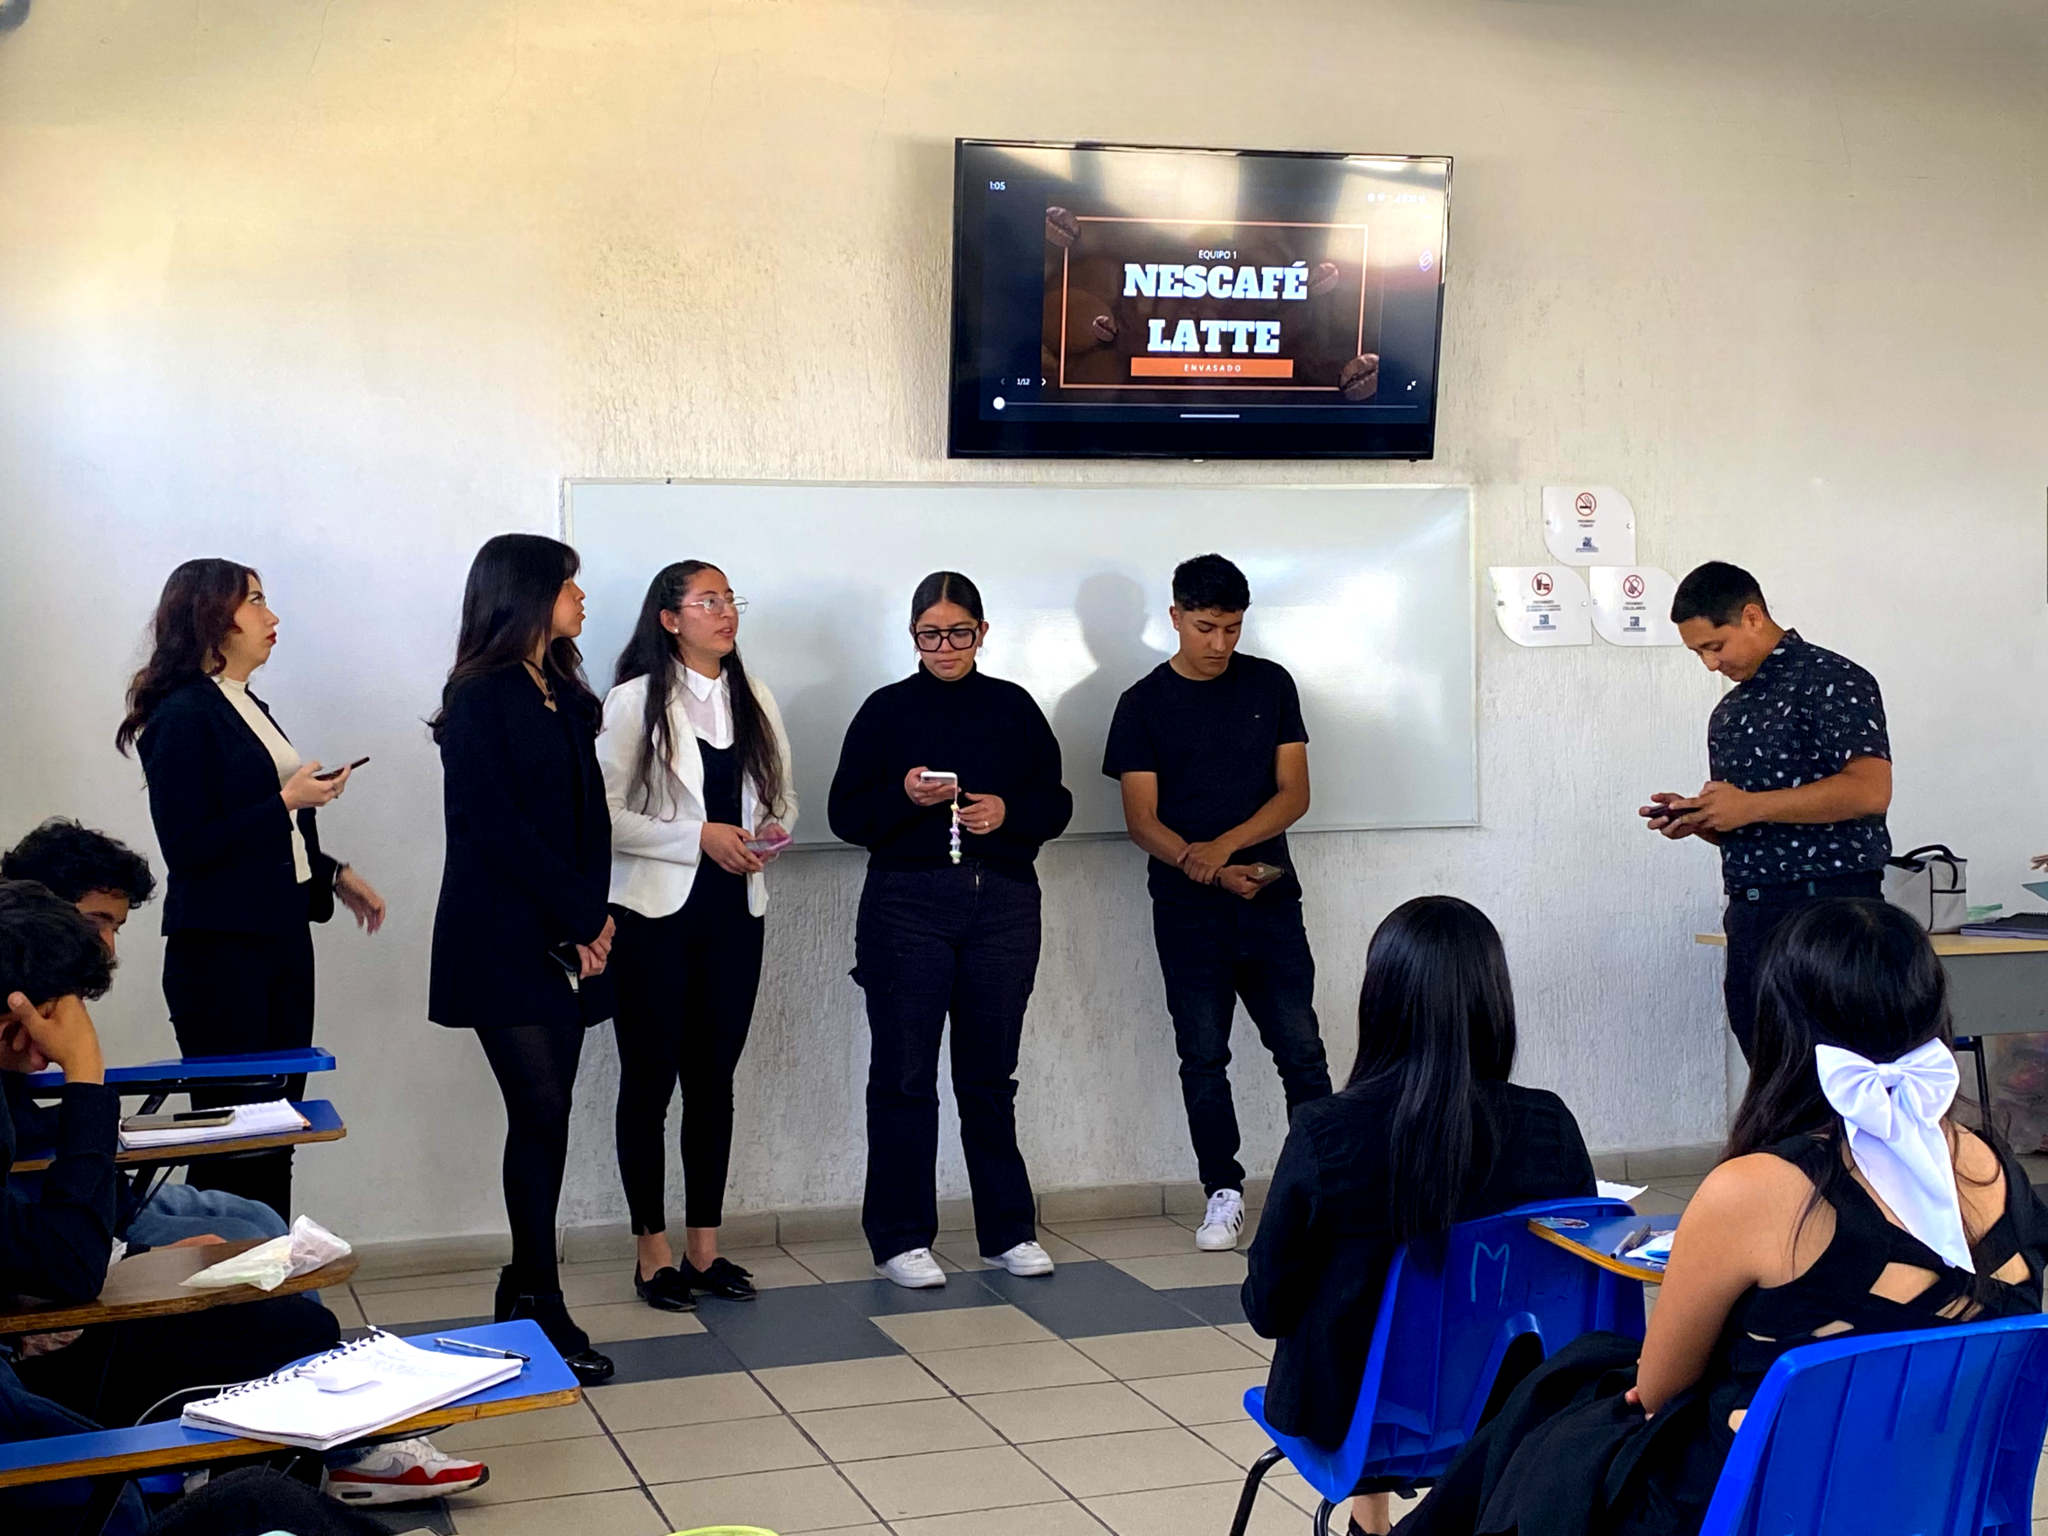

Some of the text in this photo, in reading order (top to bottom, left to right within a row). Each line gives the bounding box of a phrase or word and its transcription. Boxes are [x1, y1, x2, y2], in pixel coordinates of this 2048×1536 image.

[989, 181, 1006, 191] 1:05
[1198, 249, 1238, 260] EQUIPO 1
[1122, 260, 1309, 300] NESCAFÉ
[1147, 318, 1281, 354] LATTE
[1183, 363, 1242, 373] ENVASADO
[1470, 1241, 1510, 1309] M
